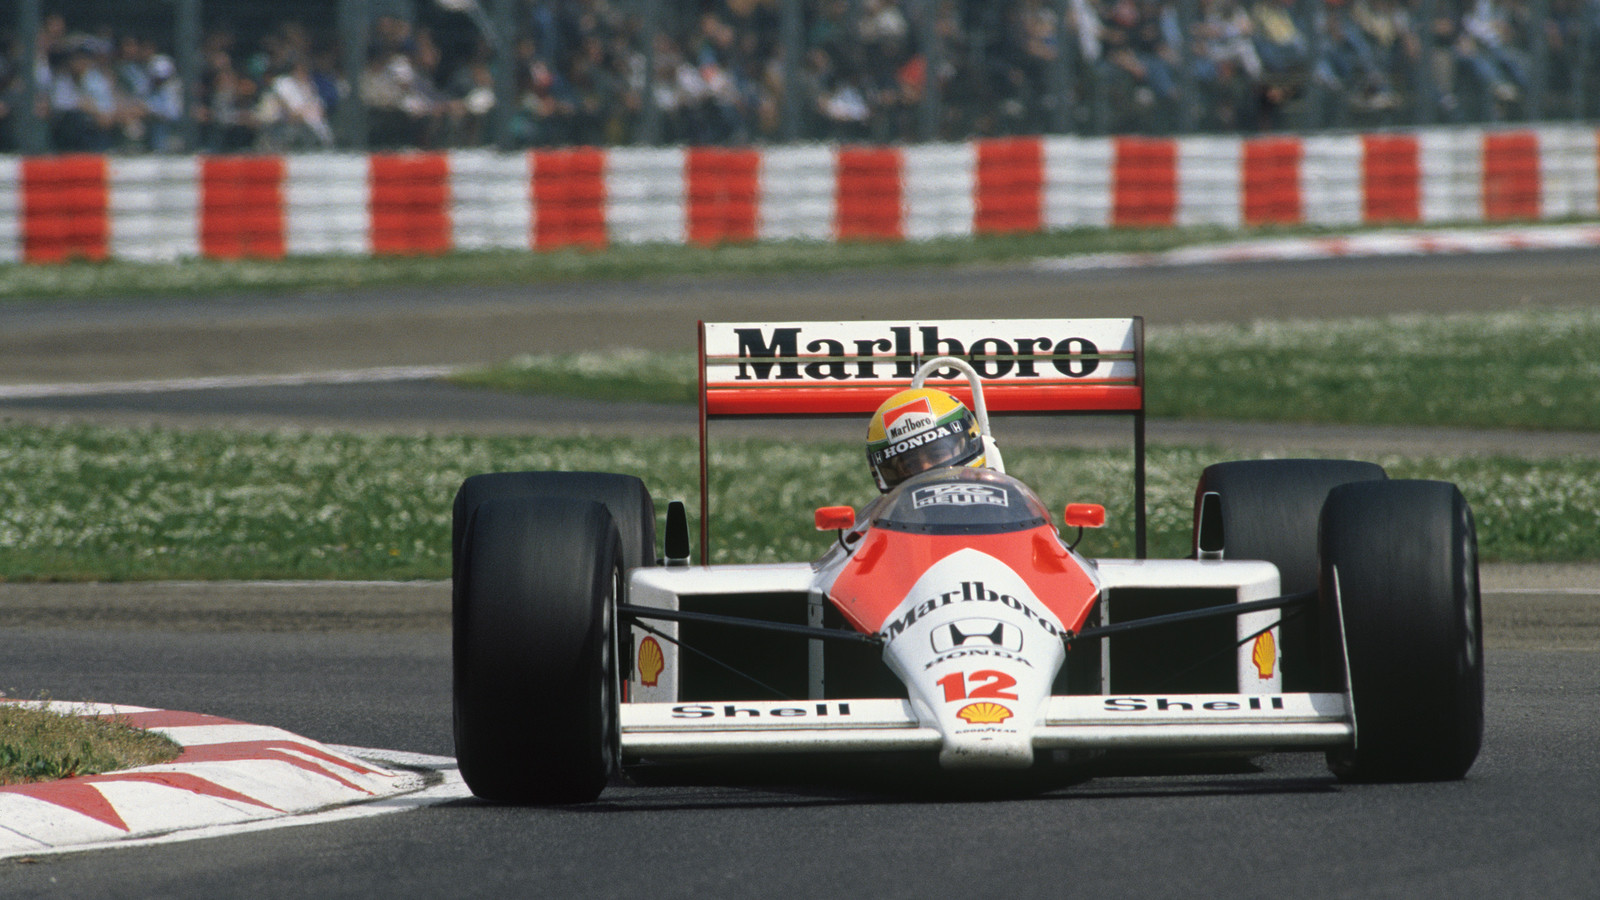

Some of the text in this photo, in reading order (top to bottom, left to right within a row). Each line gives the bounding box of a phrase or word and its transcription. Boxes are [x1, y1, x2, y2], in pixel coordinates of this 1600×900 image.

[734, 326, 1100, 380] Marlboro
[890, 416, 931, 437] Marlboro
[883, 426, 951, 459] HONDA
[887, 582, 1057, 643] Marlboro
[923, 650, 1034, 671] HONDA
[937, 669, 1018, 702] 12
[671, 703, 851, 719] Shell
[1103, 697, 1284, 712] Shell
